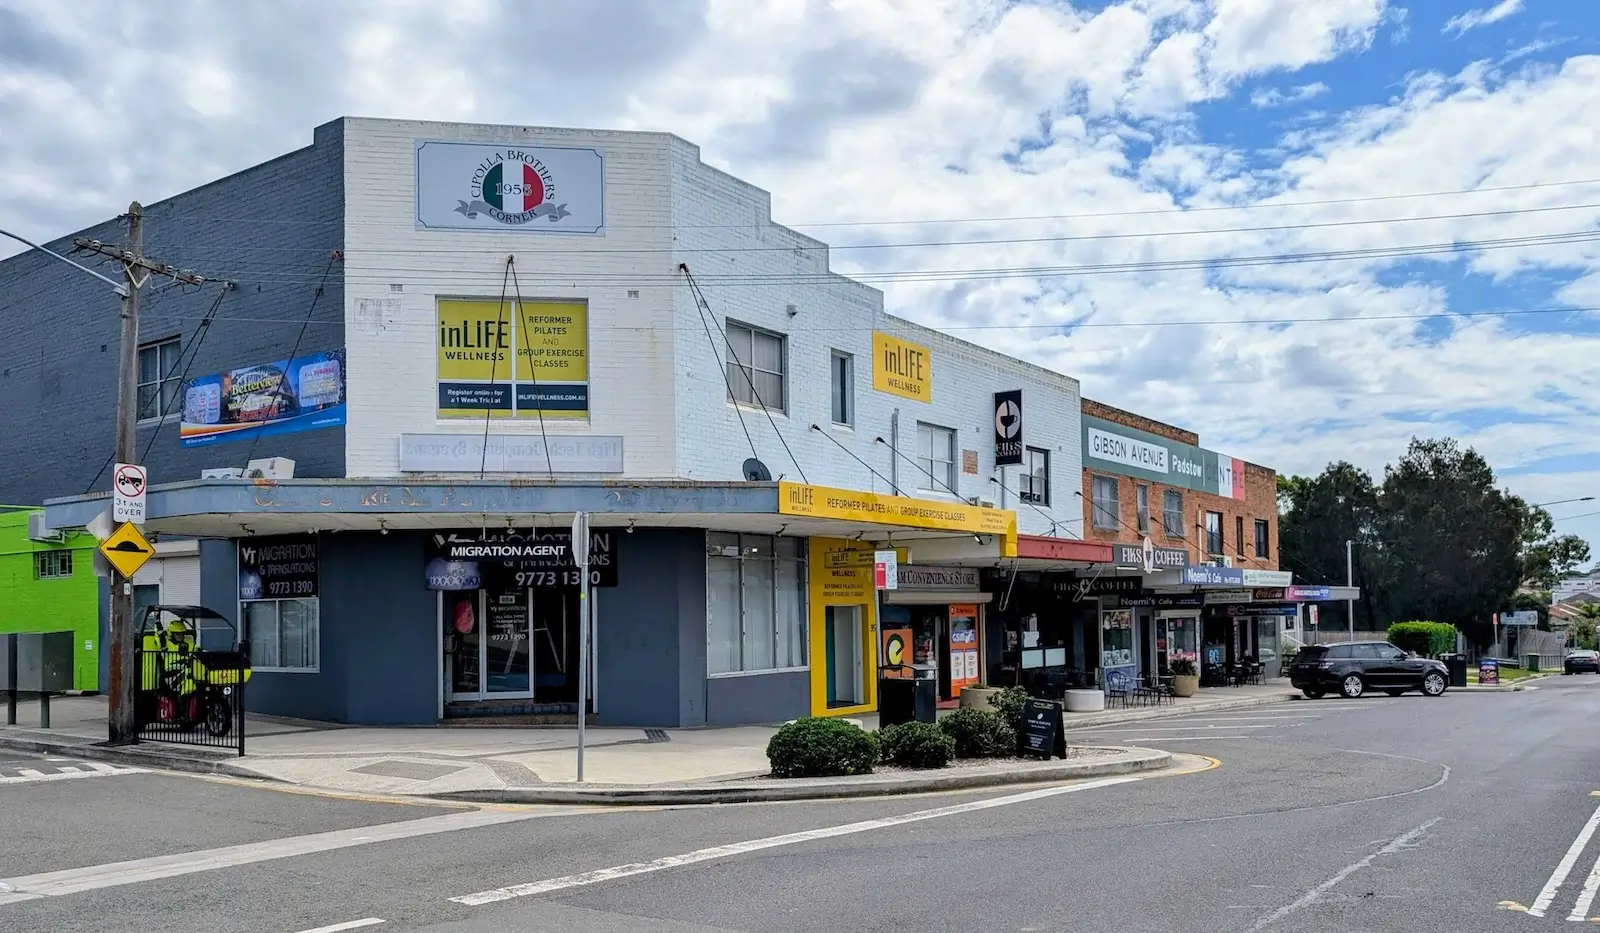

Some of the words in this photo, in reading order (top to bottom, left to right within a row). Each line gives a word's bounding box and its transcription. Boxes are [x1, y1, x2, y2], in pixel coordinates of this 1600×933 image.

[471, 152, 504, 198] CIPOLLA
[508, 150, 556, 200] BROTHERS
[488, 208, 538, 223] CORNER
[528, 316, 572, 324] REFORMER
[441, 320, 509, 348] inLIFE
[542, 338, 559, 346] AND
[445, 352, 504, 361] WELLNESS
[534, 360, 569, 368] CLASSES
[884, 342, 924, 382] inLIFE
[448, 389, 473, 397] Register
[887, 377, 921, 395] WELLNESS
[1093, 435, 1127, 458] GIBSON
[1131, 445, 1164, 467] AVENUE
[1172, 455, 1202, 478] Padstow
[790, 486, 814, 505] inLIFE
[118, 508, 142, 516] OVER
[827, 498, 860, 510] REFORMER
[861, 502, 885, 513] PILATES
[886, 505, 898, 514] AND
[900, 506, 918, 516] GROUP
[919, 508, 944, 520] EXERCISE
[945, 512, 966, 521] CLASSES
[242, 547, 256, 564] VT
[258, 544, 316, 564] MIGRATION
[451, 546, 522, 557] MIGRATION
[523, 546, 566, 556] AGENT
[1122, 547, 1142, 563] FIKS
[1155, 550, 1184, 566] COFFEE
[268, 562, 316, 577] TRANSLATIONS
[908, 570, 954, 584] CONVENIENCE
[955, 572, 975, 584] STORE
[1188, 567, 1212, 583] Noemi's
[515, 571, 557, 586] 9773
[562, 571, 601, 585] 130
[270, 582, 291, 594] 9773
[293, 581, 313, 593] 1390
[1121, 597, 1155, 606] Noemi's
